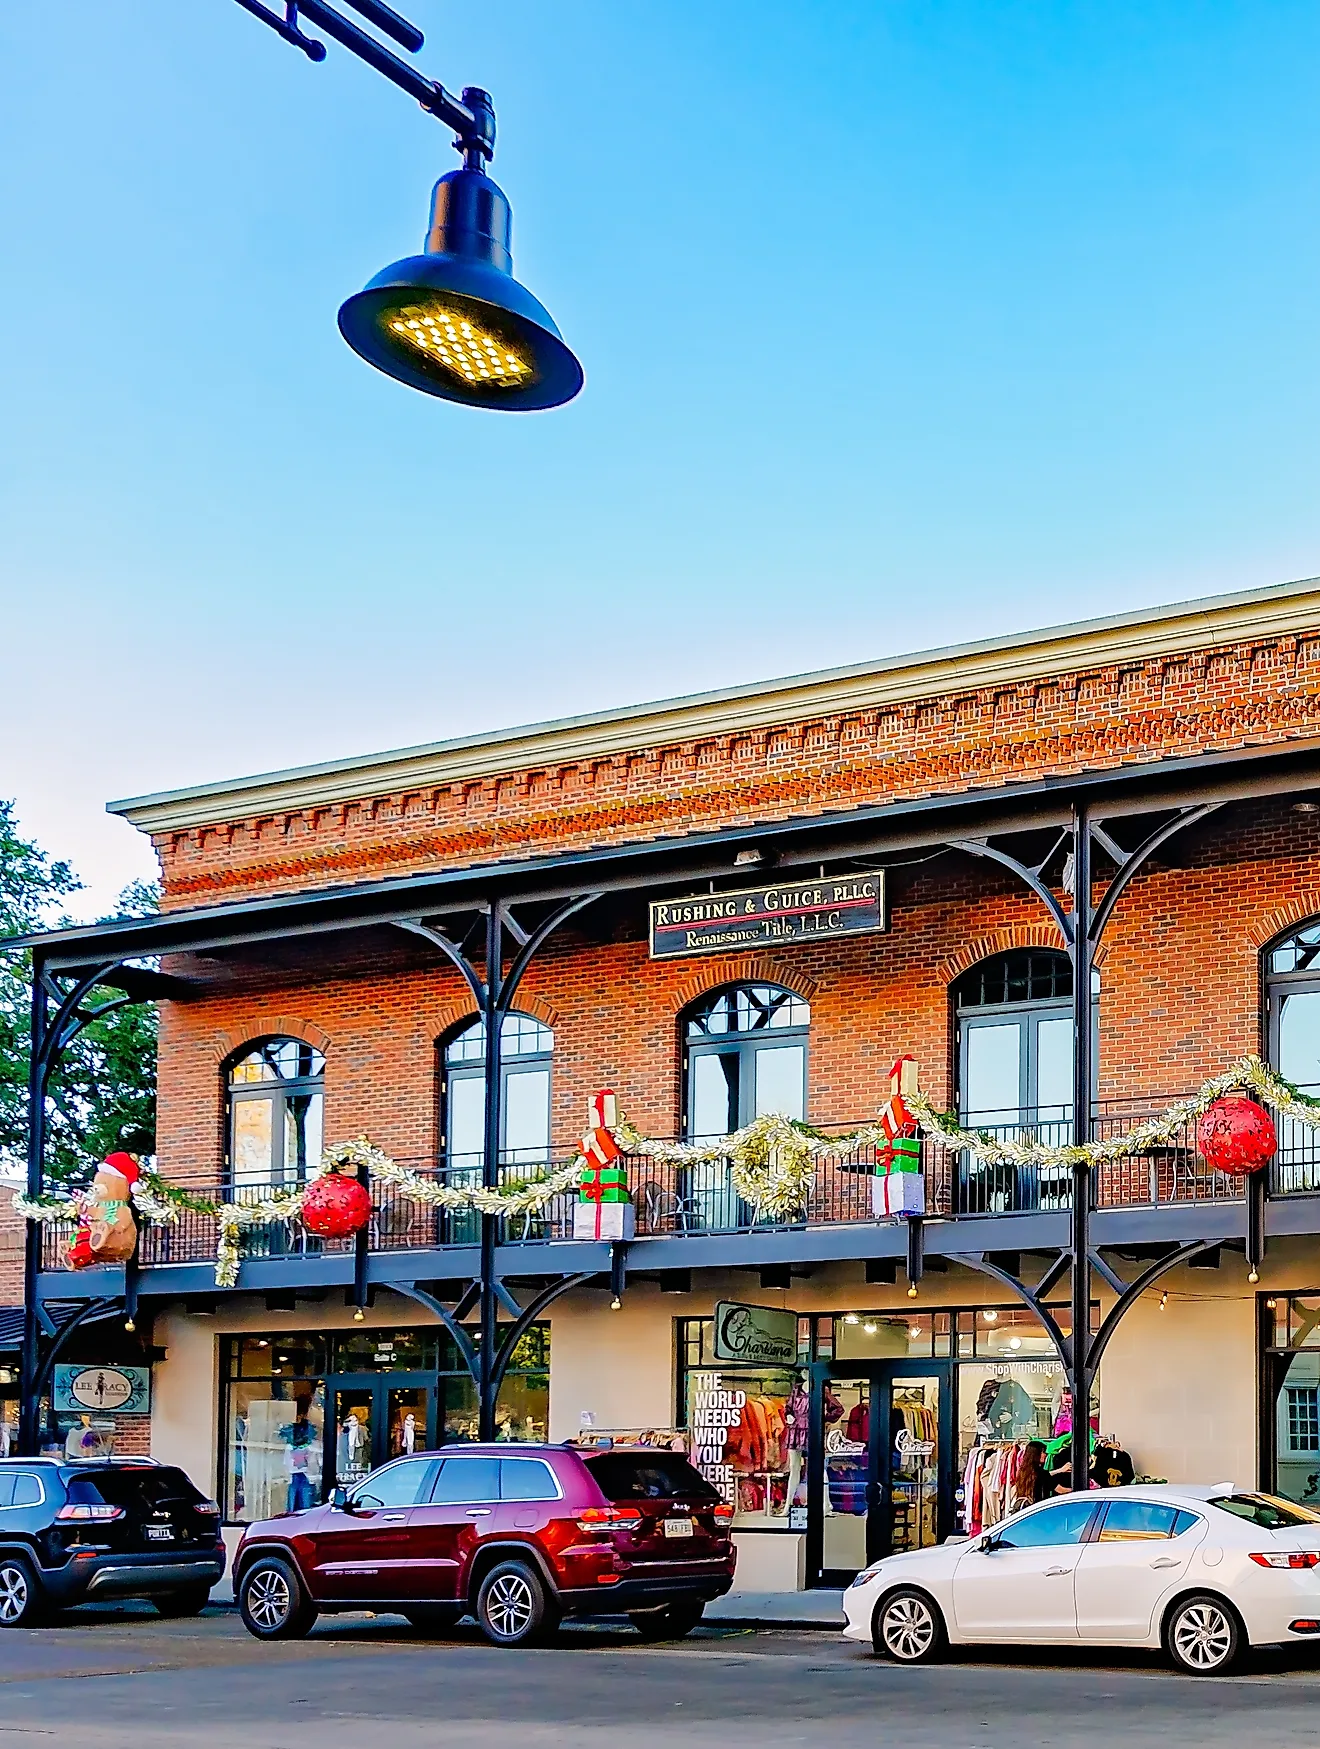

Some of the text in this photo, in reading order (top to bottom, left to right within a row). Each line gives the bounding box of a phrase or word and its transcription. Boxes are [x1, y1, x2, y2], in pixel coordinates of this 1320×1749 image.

[656, 882, 876, 926] RUSHING & GUICE, P.L.L.C.
[685, 911, 844, 948] Renaissance Title, L.L.C.
[75, 1382, 92, 1390] LEE
[695, 1372, 722, 1390] THE
[695, 1391, 746, 1409] WORLD
[694, 1409, 741, 1427] NEEDS
[694, 1427, 728, 1446] WHO
[694, 1446, 723, 1463] YOU
[715, 1483, 735, 1501] DE
